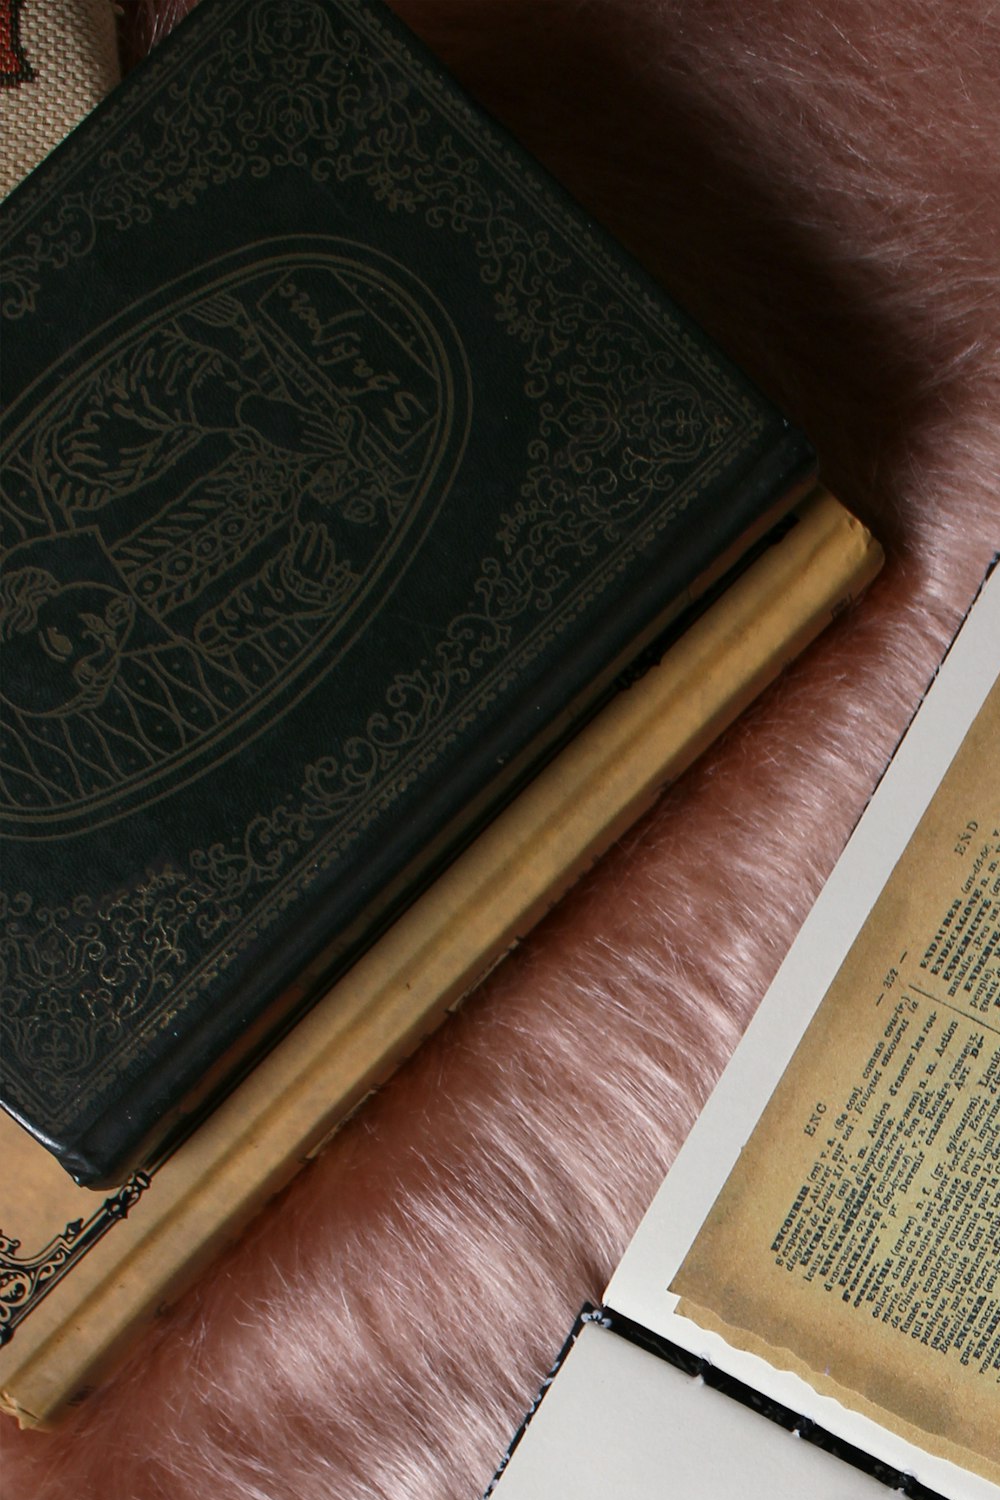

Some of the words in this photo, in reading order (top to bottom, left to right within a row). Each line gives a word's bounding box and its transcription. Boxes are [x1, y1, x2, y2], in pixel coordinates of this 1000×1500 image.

[803, 1102, 827, 1138] ENC
[883, 968, 899, 989] 352
[954, 821, 978, 856] END
[799, 1205, 836, 1267] ENCRAGE
[867, 1102, 891, 1139] Action
[855, 1117, 896, 1186] d'imprimerie.
[898, 1150, 925, 1195] Devenir
[770, 1185, 811, 1253] ENCOURIR
[819, 1172, 877, 1277] ENCRASSEMENT
[945, 1256, 970, 1294] liquide
